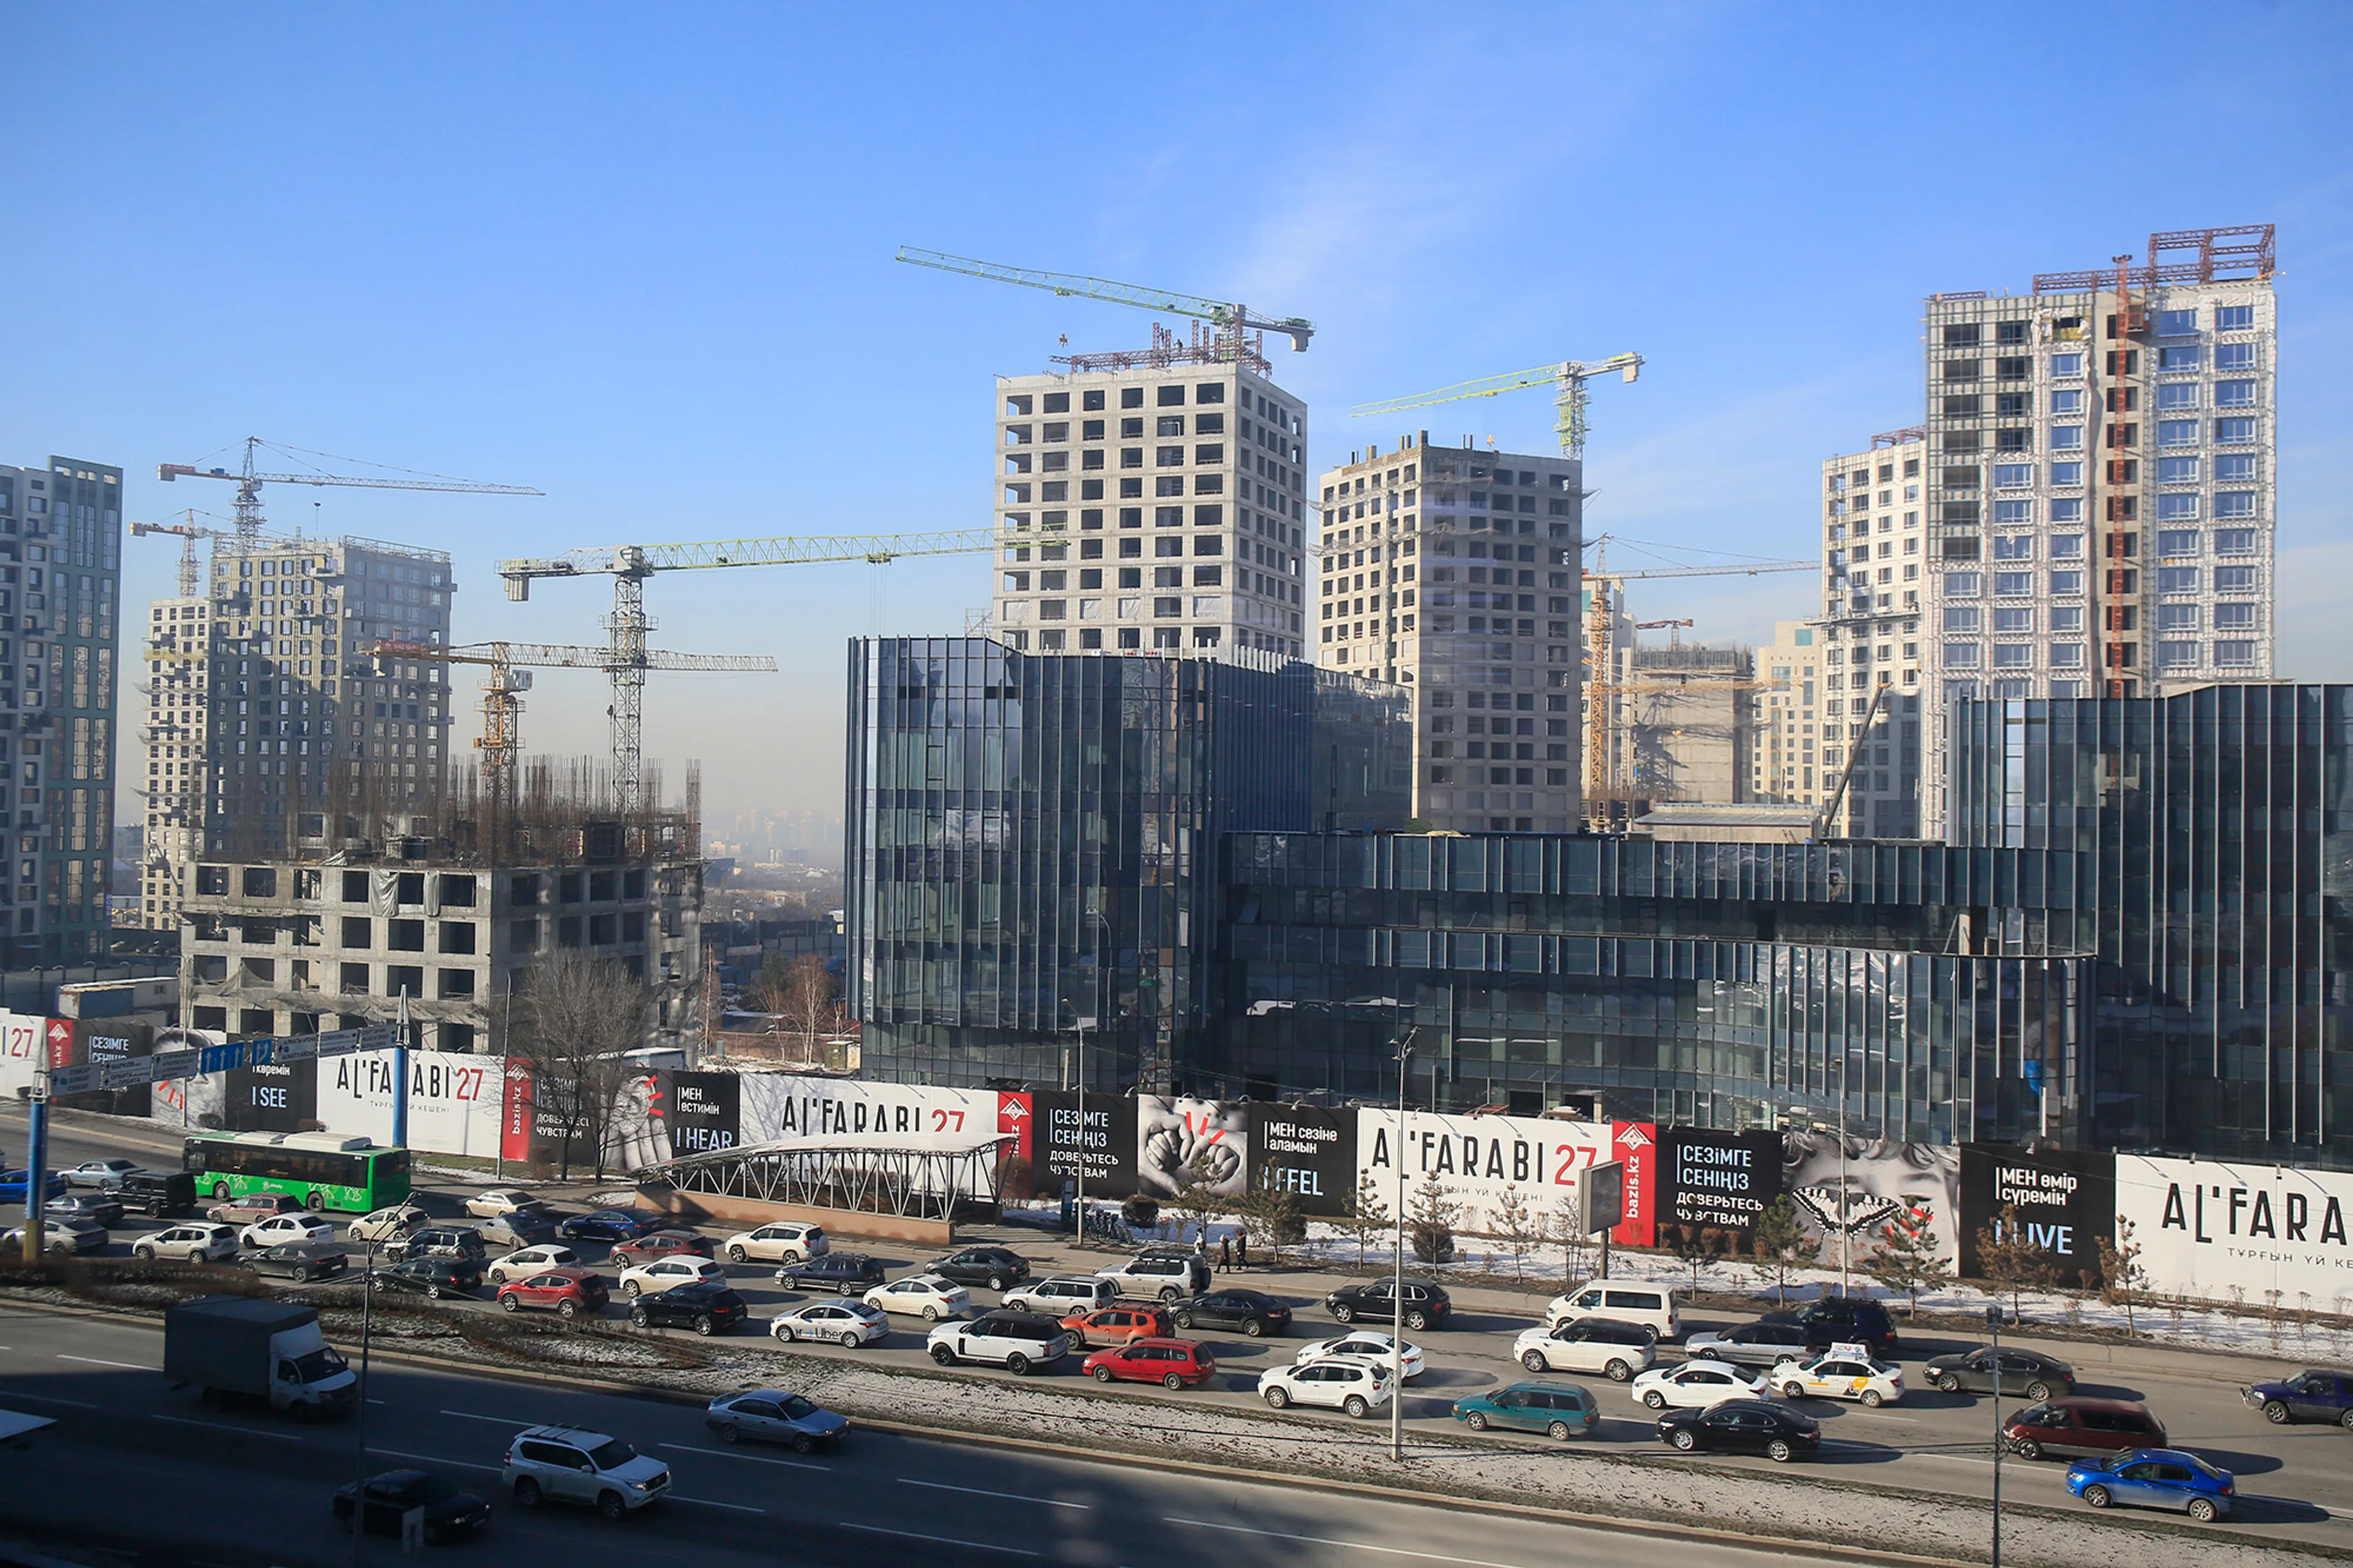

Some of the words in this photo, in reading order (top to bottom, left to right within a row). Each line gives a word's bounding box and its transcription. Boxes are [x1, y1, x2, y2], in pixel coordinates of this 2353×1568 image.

[11, 1028, 34, 1058] 27
[337, 1058, 449, 1099] AL'FAABI
[457, 1067, 483, 1101] 27
[260, 1087, 287, 1108] SEE
[681, 1086, 702, 1100] МЕН
[512, 1086, 521, 1135] bazis.kz
[681, 1102, 720, 1115] естимін
[1055, 1109, 1109, 1127] СЕЗМГЕ
[931, 1108, 965, 1132] 27
[686, 1127, 733, 1150] HEAR
[1055, 1129, 1107, 1149] СЕНҢІЗ
[1270, 1121, 1295, 1138] МЕН
[1298, 1126, 1338, 1142] сезіне
[1269, 1138, 1317, 1154] аламын
[1049, 1165, 1107, 1179] ЧУВСВАМ
[1554, 1144, 1597, 1186] 27
[1626, 1154, 1640, 1219] bazis.kz
[1683, 1167, 1749, 1192] СЕНІҢІЗ
[2002, 1167, 2037, 1186] МЕН
[2040, 1173, 2078, 1194] өмір
[1677, 1192, 1764, 1211] ДОВЕРЬТЕСЬ
[2001, 1187, 2067, 1206] сүремін
[2161, 1183, 2347, 1246] AL'FARA
[2227, 1248, 2293, 1262] ТҰРҒЫН
[2305, 1255, 2325, 1266] ҮЙ
